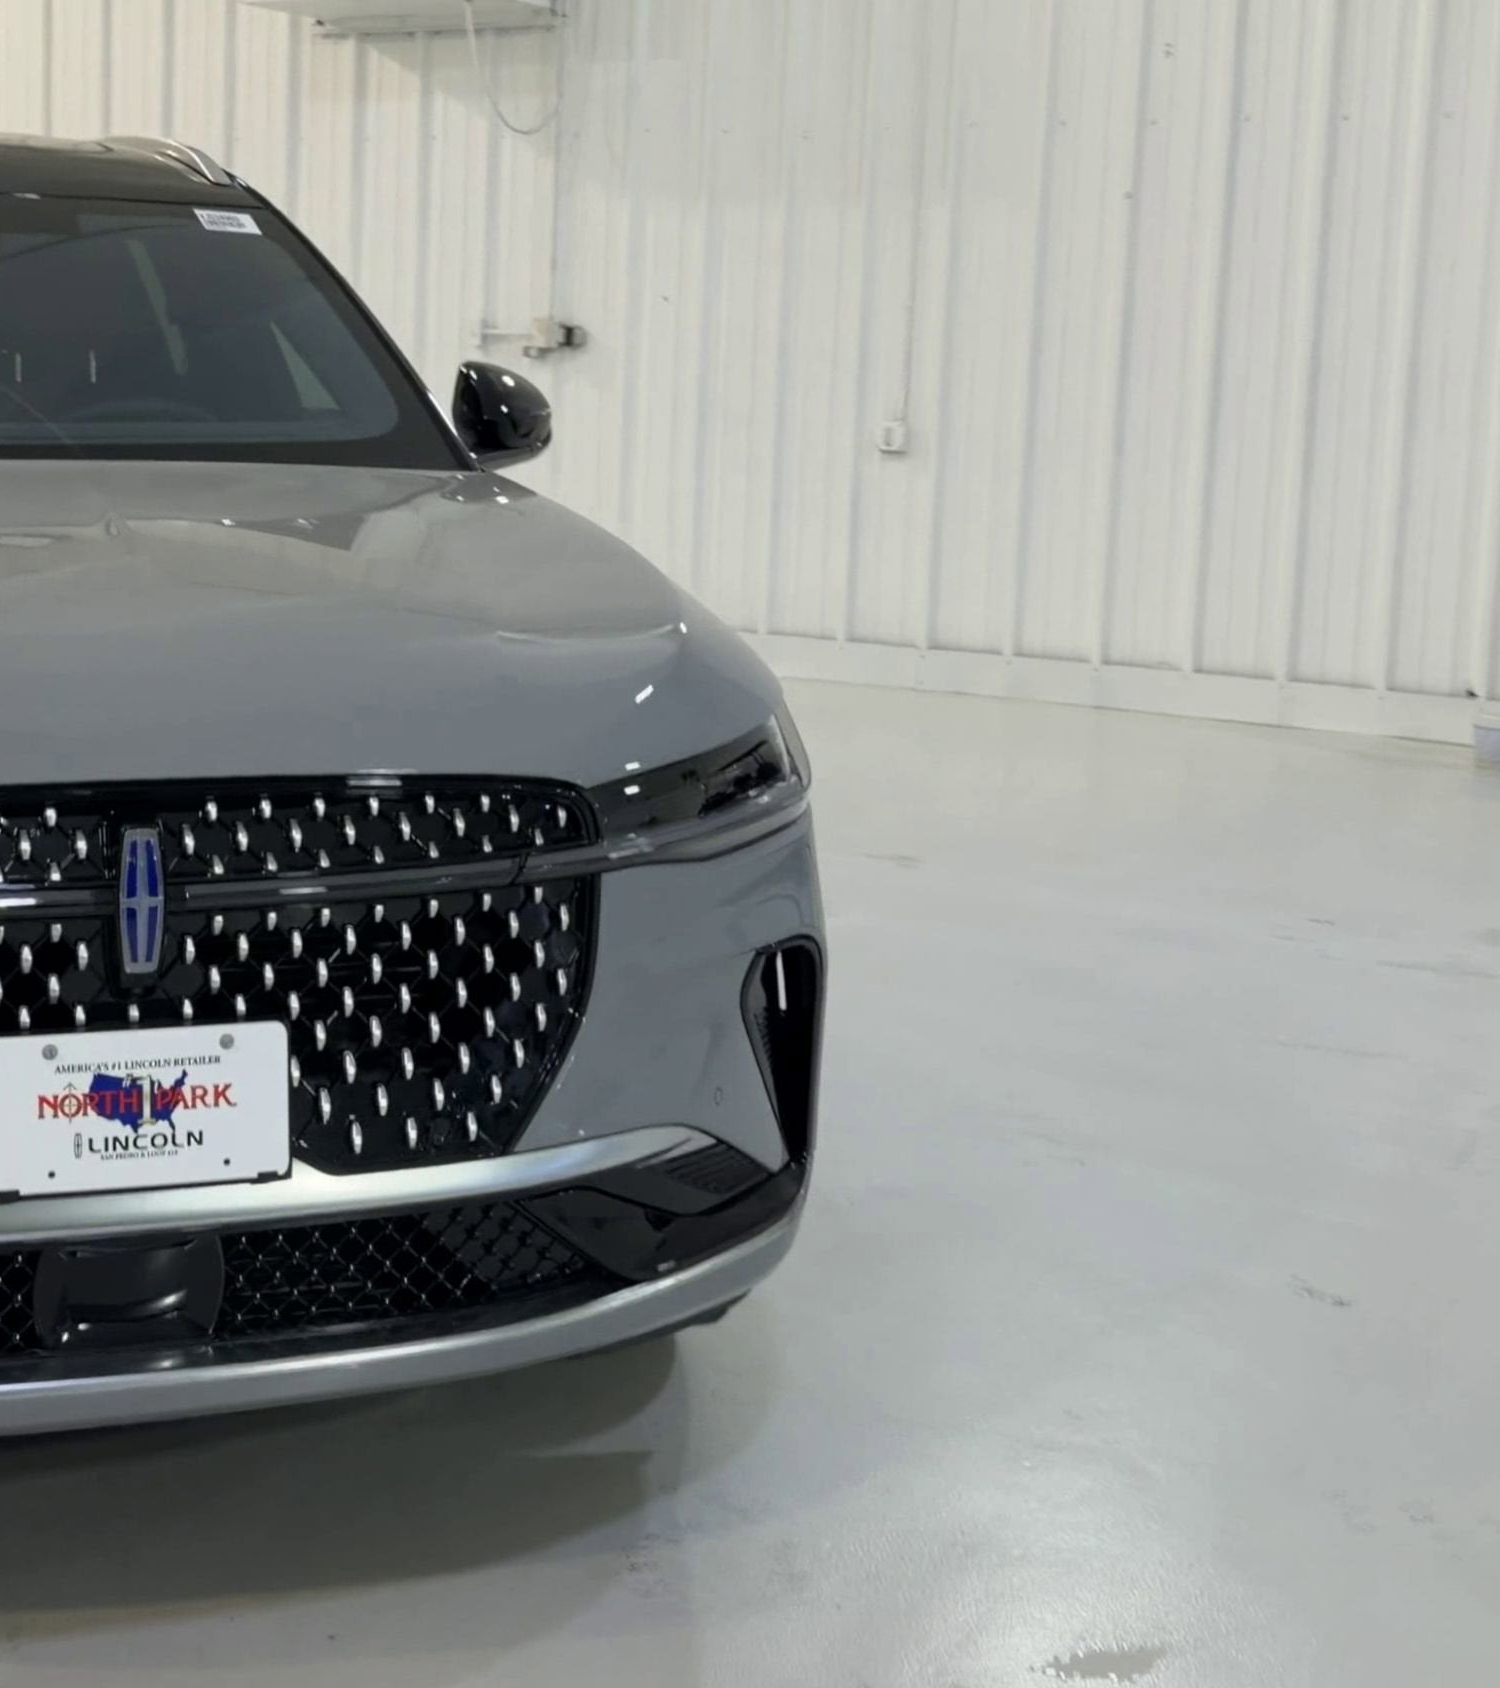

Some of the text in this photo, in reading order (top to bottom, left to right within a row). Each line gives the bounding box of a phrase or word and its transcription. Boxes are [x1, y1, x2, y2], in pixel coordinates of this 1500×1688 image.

[54, 1055, 221, 1074] AMERICA'S #1 LINCOLN RETAILER
[38, 1082, 237, 1120] NORTH PARK
[88, 1130, 204, 1154] LINCOLN
